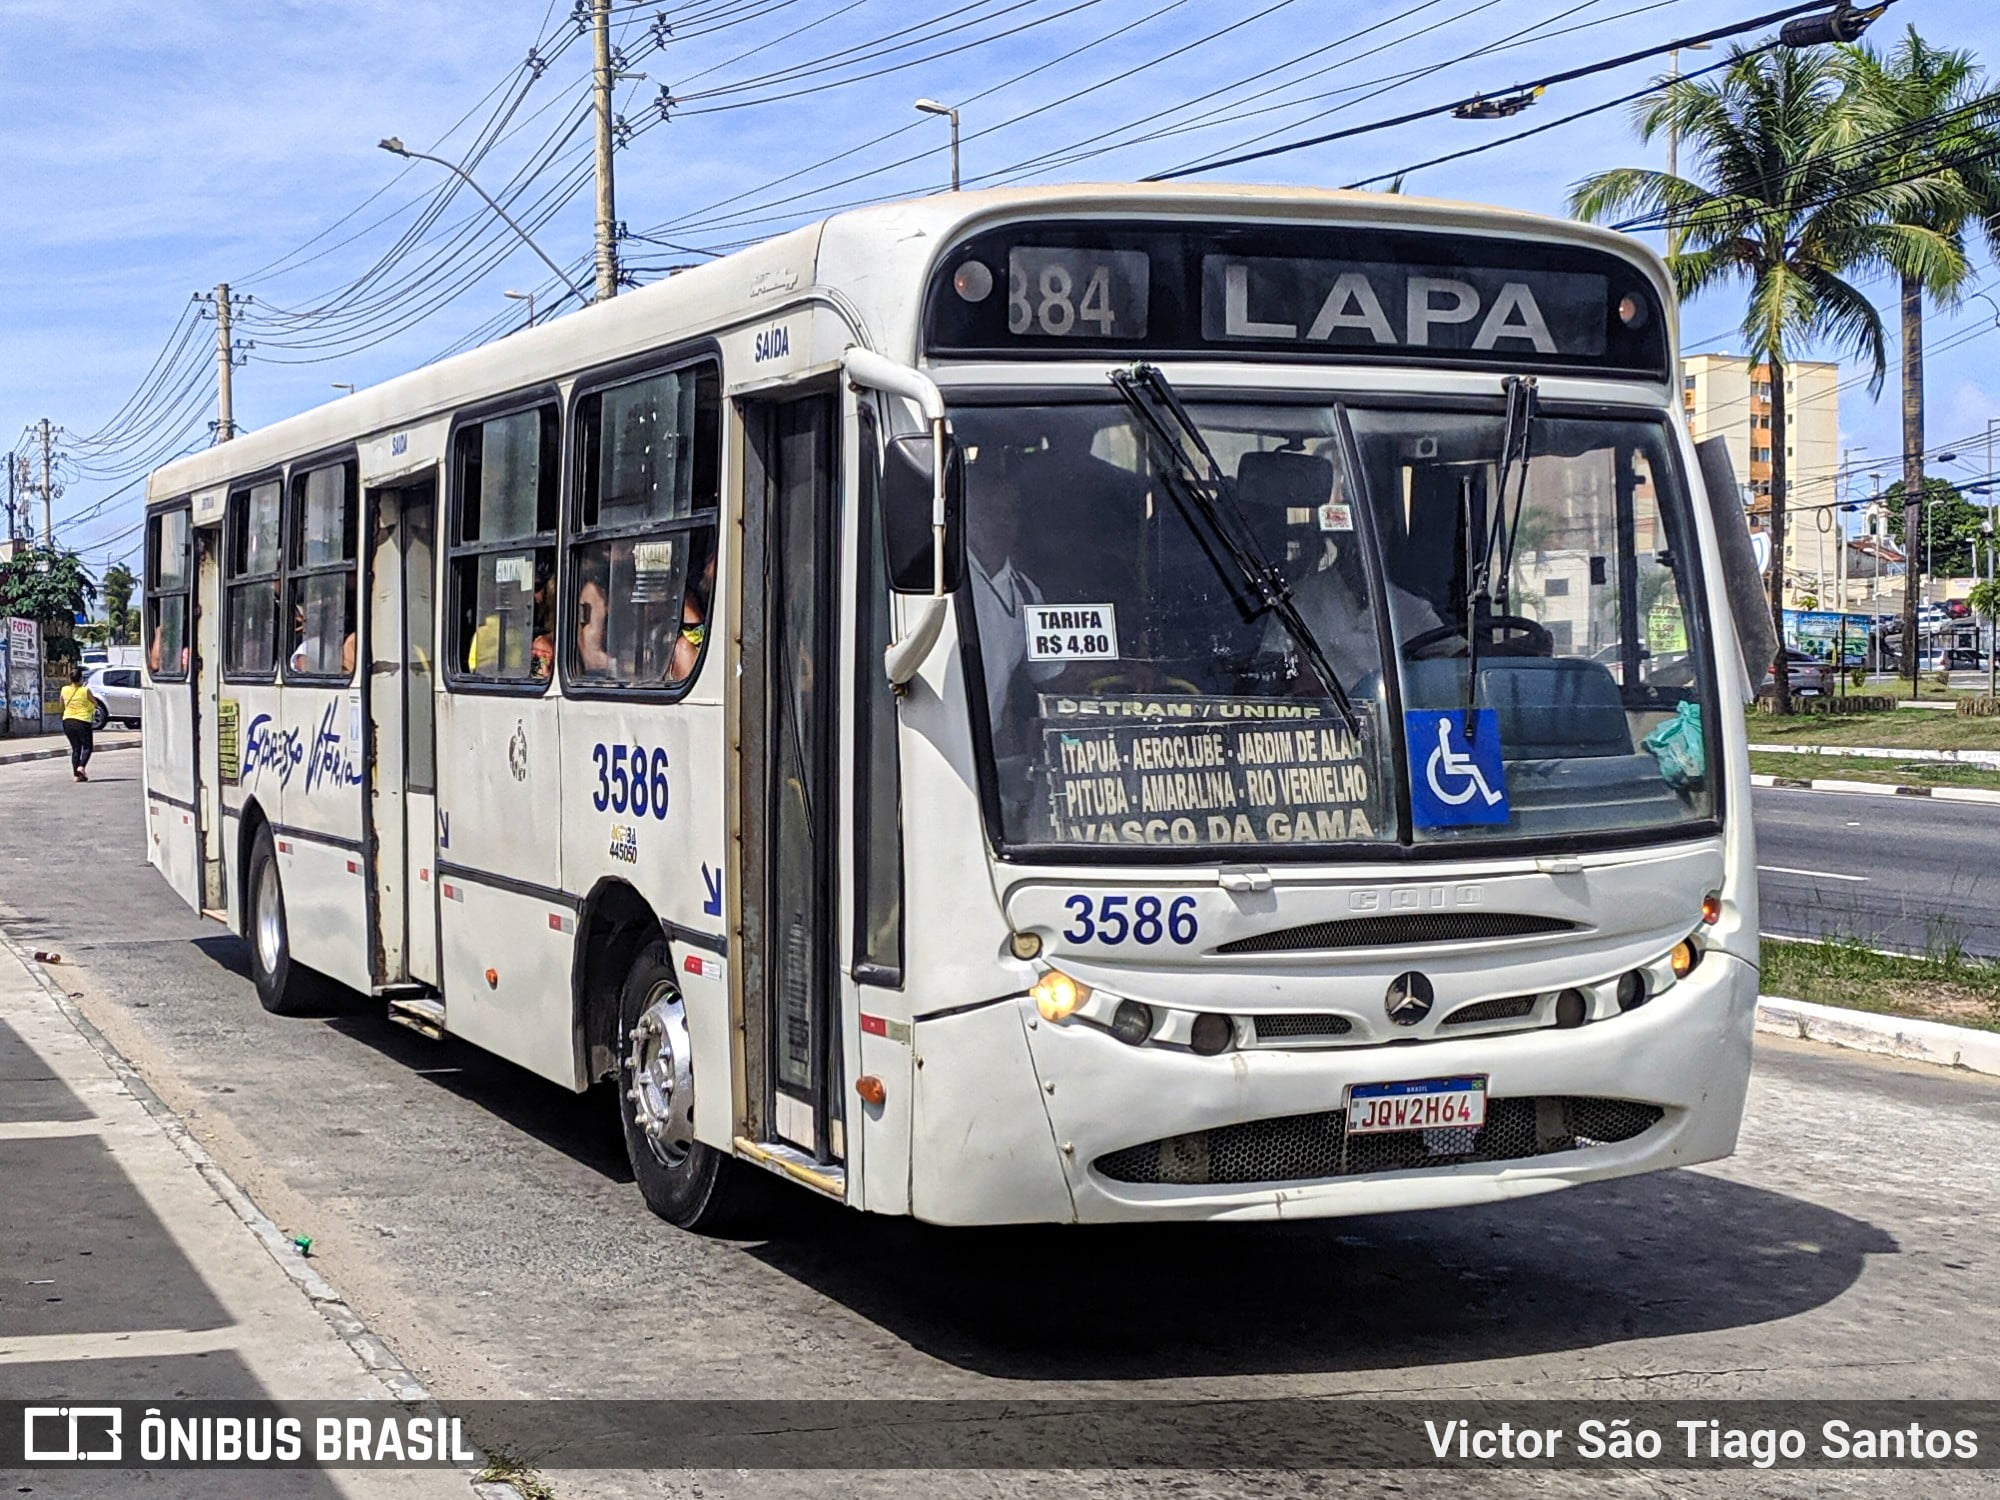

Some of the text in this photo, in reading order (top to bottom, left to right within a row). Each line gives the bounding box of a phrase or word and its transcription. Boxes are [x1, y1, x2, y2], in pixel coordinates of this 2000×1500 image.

[1225, 264, 1558, 354] LAPA
[754, 321, 790, 362] SAÍDA
[1037, 611, 1102, 629] TARIFA
[1036, 634, 1109, 655] R$ 4,80
[1133, 734, 1225, 771] AEROCLUBE
[1237, 731, 1294, 765] JARDIM
[1295, 729, 1318, 762] DE
[592, 743, 669, 820] 3586
[1065, 777, 1129, 817] PITUBA
[1142, 771, 1237, 813] AMARALINA
[1246, 769, 1276, 806] RIO
[1278, 764, 1368, 805] VERMELHO
[1070, 808, 1375, 843] VASCO DA GAMA
[1063, 894, 1198, 945] 3586
[1362, 1094, 1471, 1128] JQW2H64
